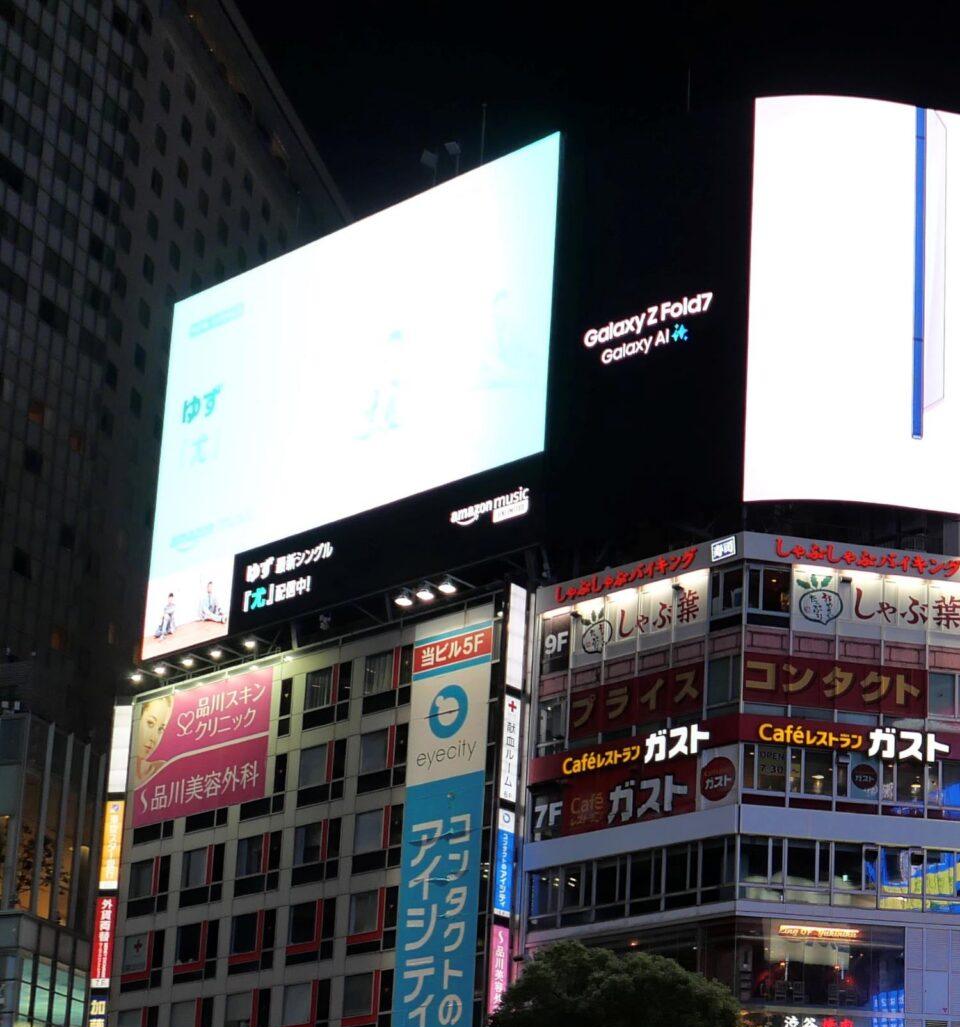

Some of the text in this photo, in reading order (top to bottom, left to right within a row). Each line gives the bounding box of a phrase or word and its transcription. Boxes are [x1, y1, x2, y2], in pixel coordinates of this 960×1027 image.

[584, 291, 713, 347] Galaxy Z Fold7
[602, 328, 670, 364] Galaxy AI
[450, 500, 493, 526] amazon
[493, 486, 530, 509] music
[245, 557, 275, 583] ゆず
[555, 547, 698, 604] しゃぶしゃぶバイキング
[618, 590, 700, 638] しゃぶ葉
[420, 631, 485, 668] 当ビル5F
[544, 630, 570, 655] 9F
[195, 682, 266, 720] 品川スキン
[572, 671, 700, 729] プライス
[745, 660, 921, 705] コンタクト
[195, 709, 257, 741] クリニック
[644, 723, 710, 764] ガスト
[868, 727, 950, 762] ガスト
[415, 739, 477, 770] eyecity
[504, 722, 516, 788] 献血ルーム
[149, 761, 260, 812] 品川美容外科
[607, 774, 688, 825] ガスト
[704, 775, 733, 791] ガスト
[534, 801, 563, 829] 7F
[437, 813, 473, 1026] コンタクトの
